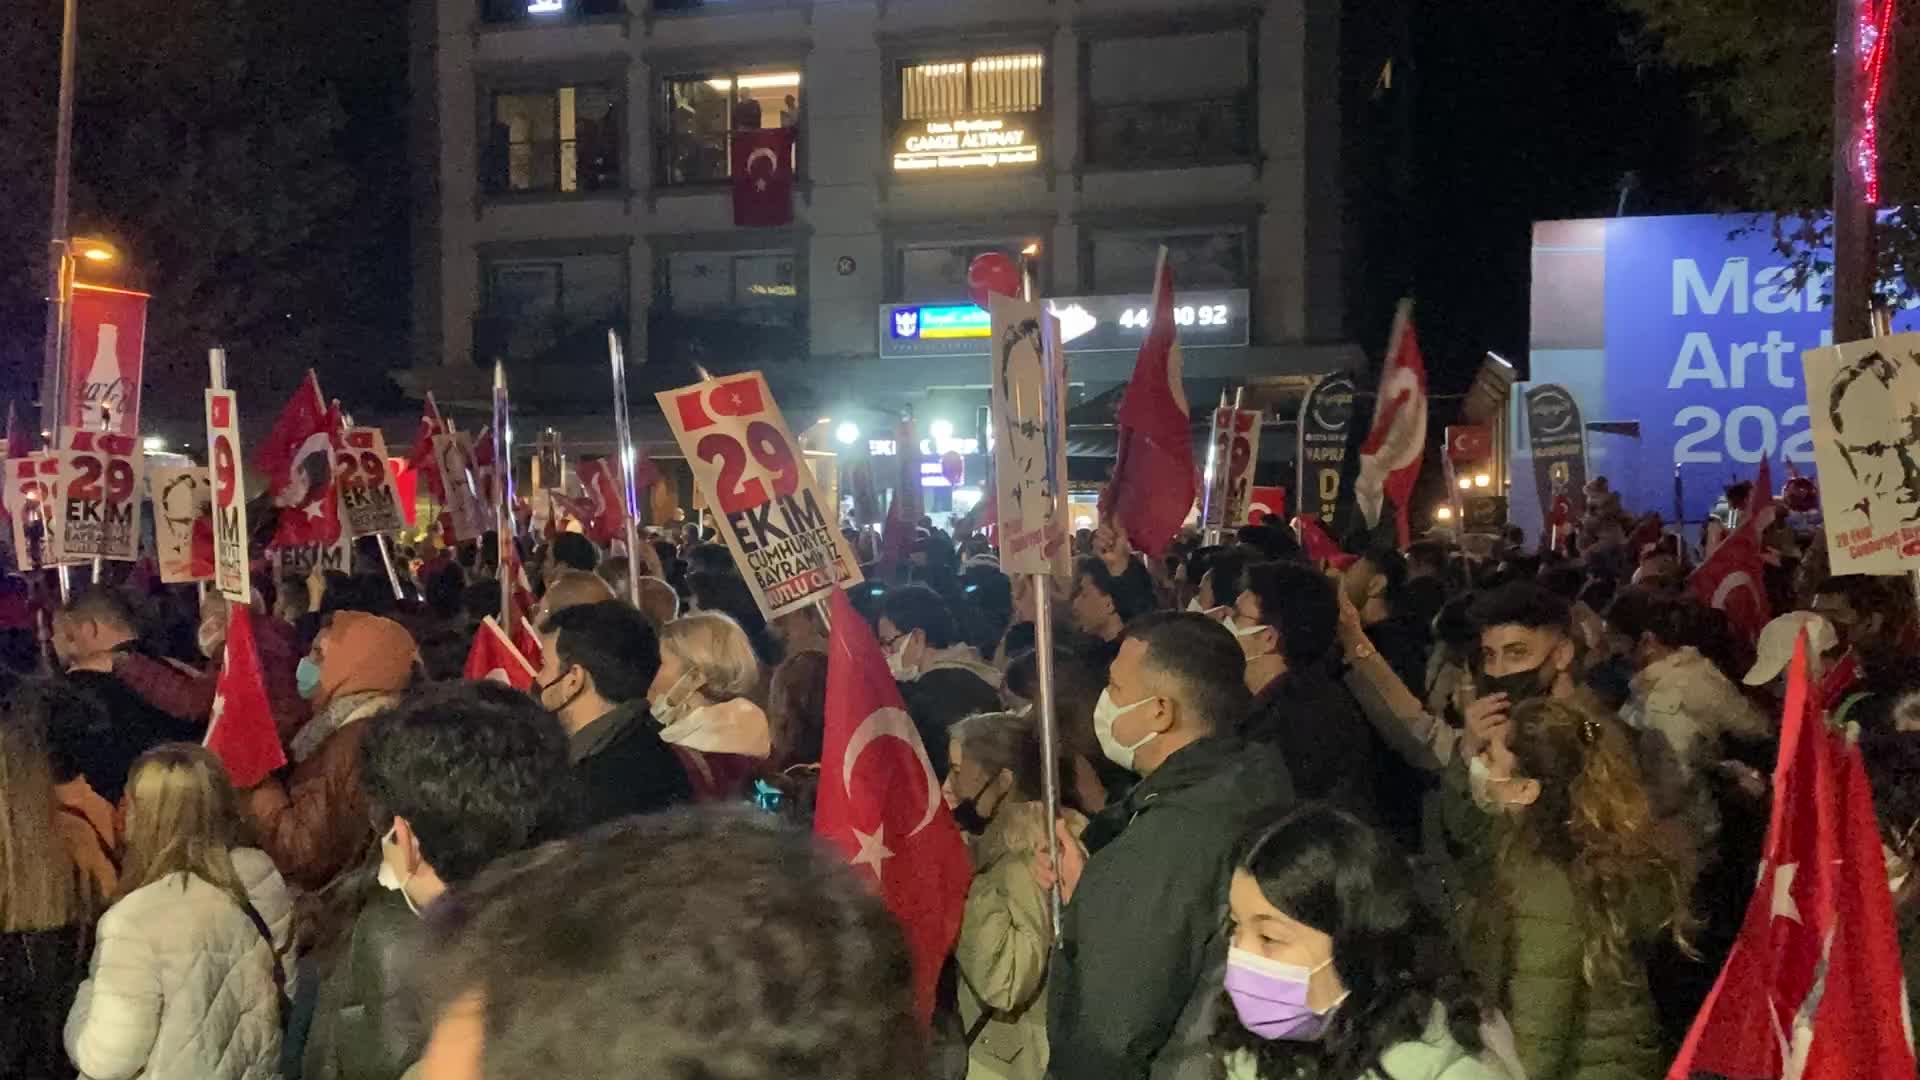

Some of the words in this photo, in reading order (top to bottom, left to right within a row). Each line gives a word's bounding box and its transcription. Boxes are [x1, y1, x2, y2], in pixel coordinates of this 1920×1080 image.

[1198, 304, 1228, 325] 92
[1667, 330, 1796, 390] Art
[67, 455, 135, 502] 29
[337, 451, 390, 491] 29
[697, 420, 799, 514] 29
